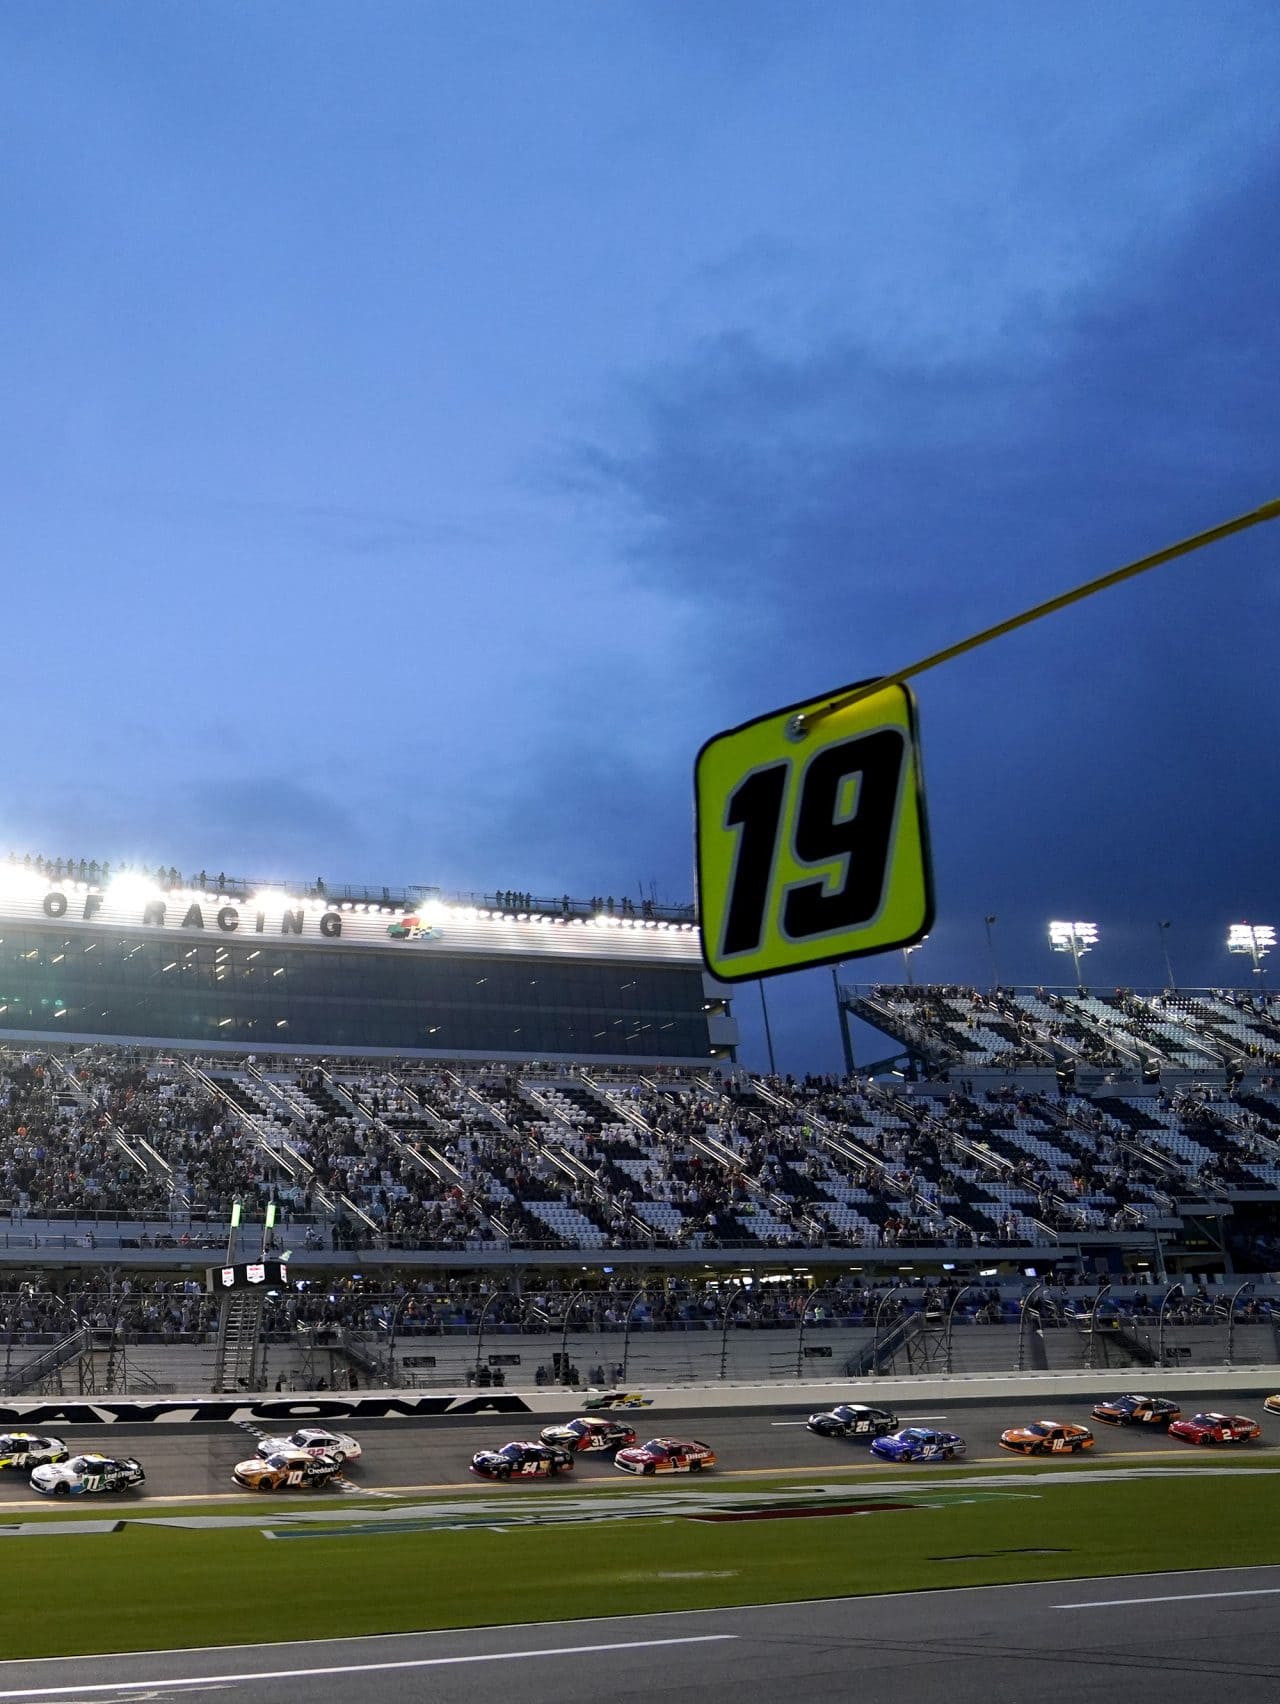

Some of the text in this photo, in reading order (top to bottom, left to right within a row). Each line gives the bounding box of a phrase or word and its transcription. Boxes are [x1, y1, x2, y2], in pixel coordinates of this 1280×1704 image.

[719, 726, 910, 959] 19
[43, 891, 105, 920] OF
[143, 901, 342, 937] RACING
[1221, 1429, 1233, 1440] 2
[590, 1435, 604, 1447] 31
[1052, 1438, 1065, 1450] 18
[923, 1445, 936, 1457] 92
[521, 1462, 538, 1474] 54
[670, 1456, 680, 1469] 1
[287, 1471, 303, 1485] 10
